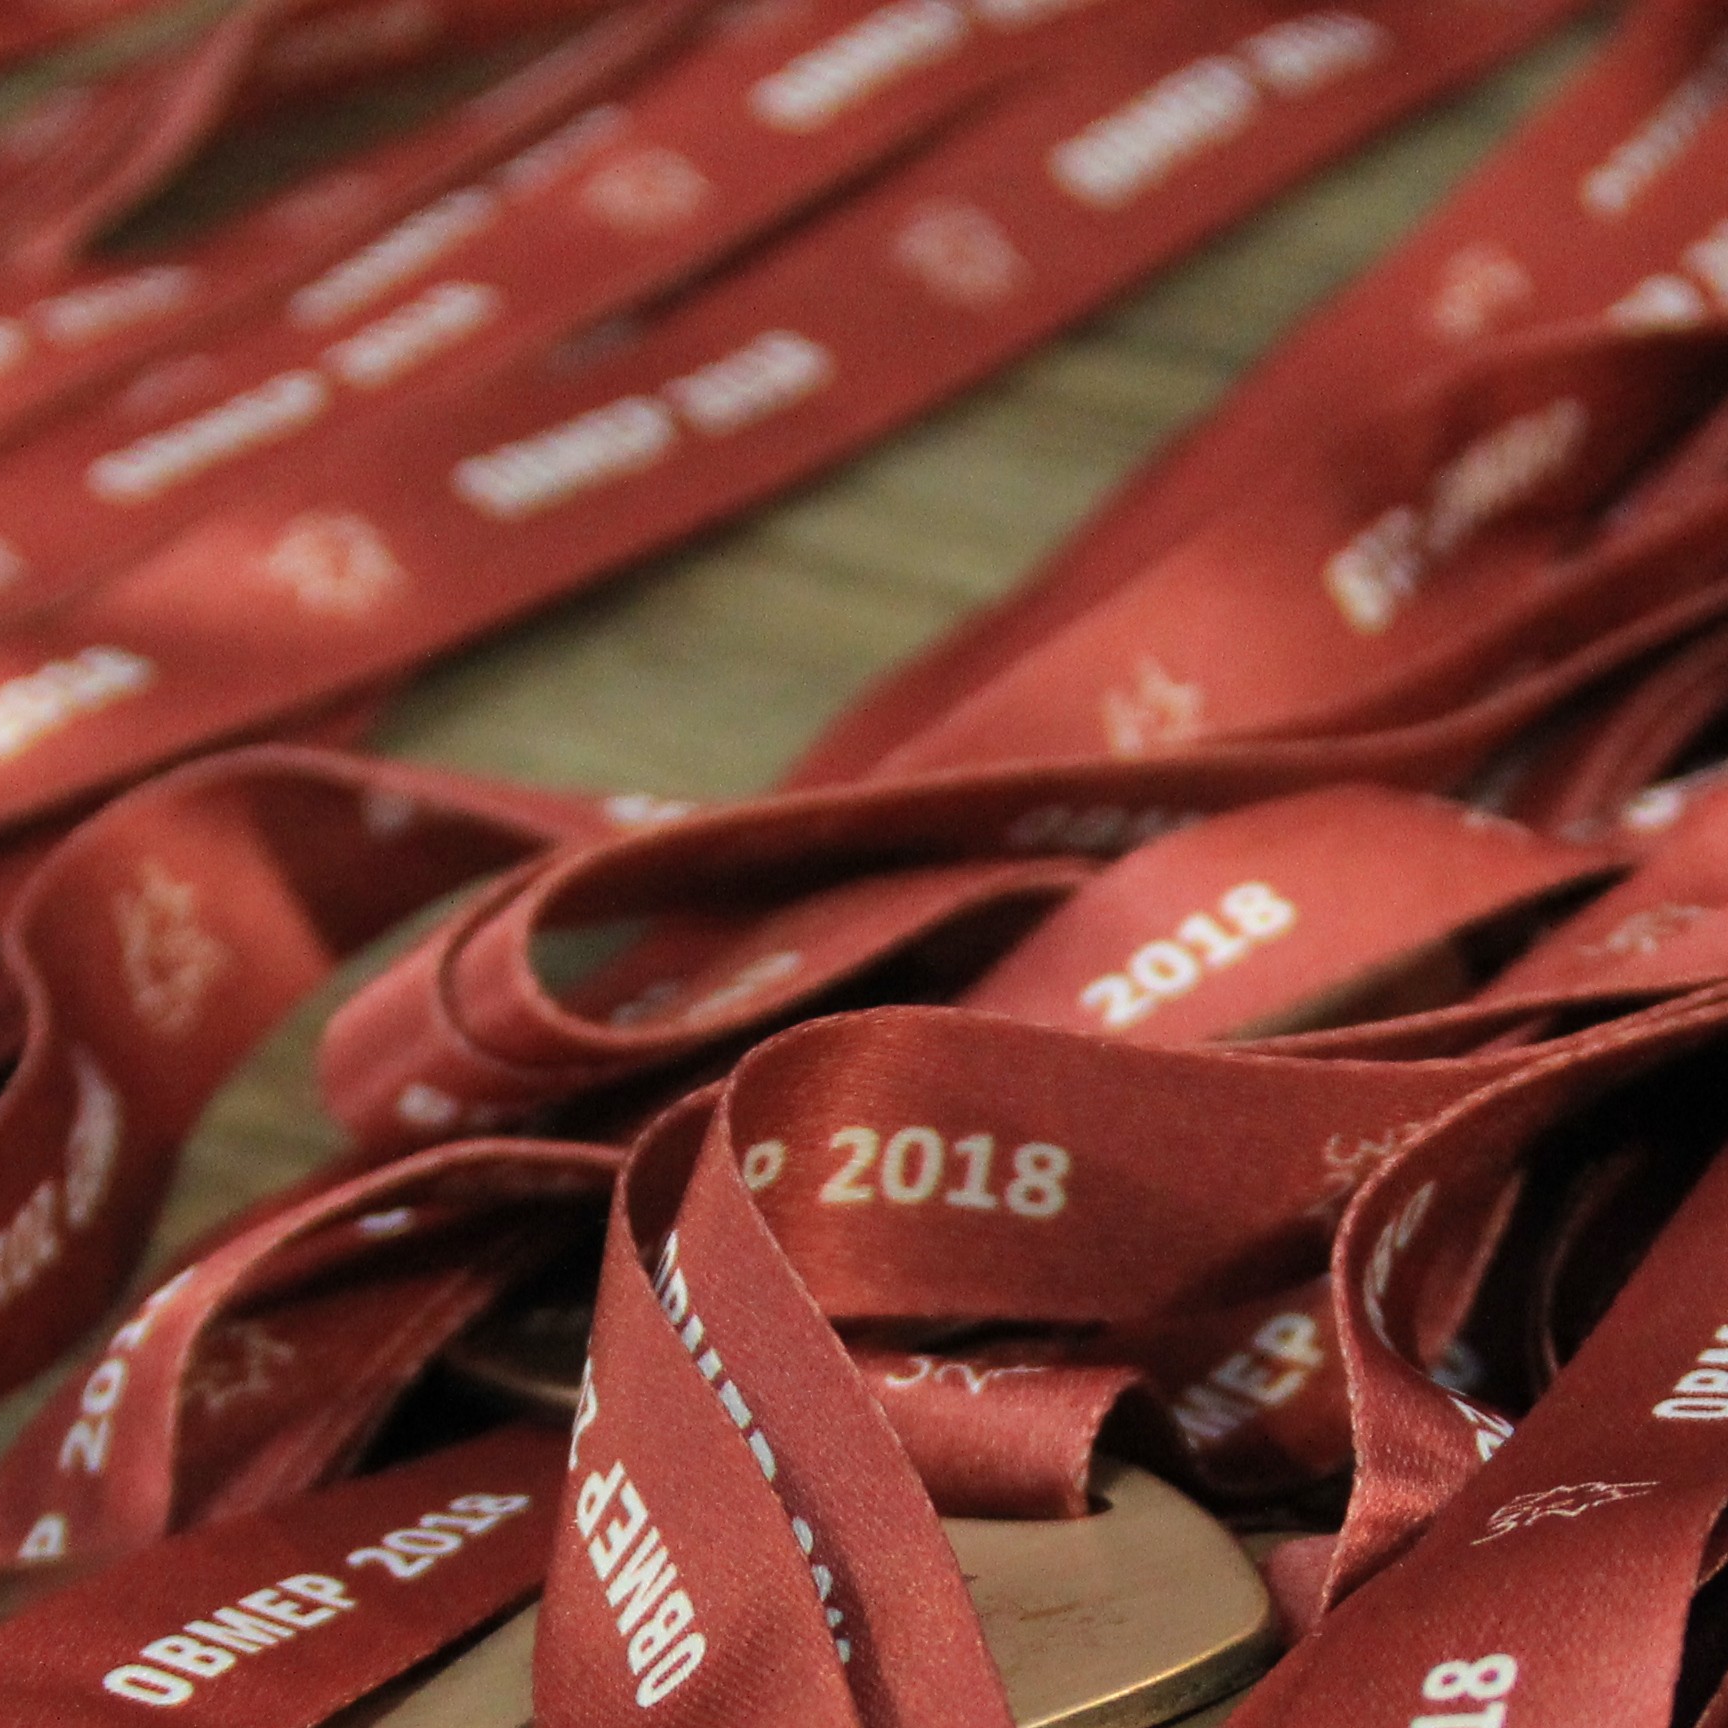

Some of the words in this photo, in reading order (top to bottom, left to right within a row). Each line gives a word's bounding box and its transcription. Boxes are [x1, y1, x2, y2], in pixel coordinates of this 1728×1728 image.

[1079, 880, 1296, 1028] 2018
[821, 1126, 1072, 1219] 2018
[103, 1573, 358, 1707] OBMEP
[347, 1493, 530, 1580] 2018
[576, 1460, 708, 1708] OBMEP
